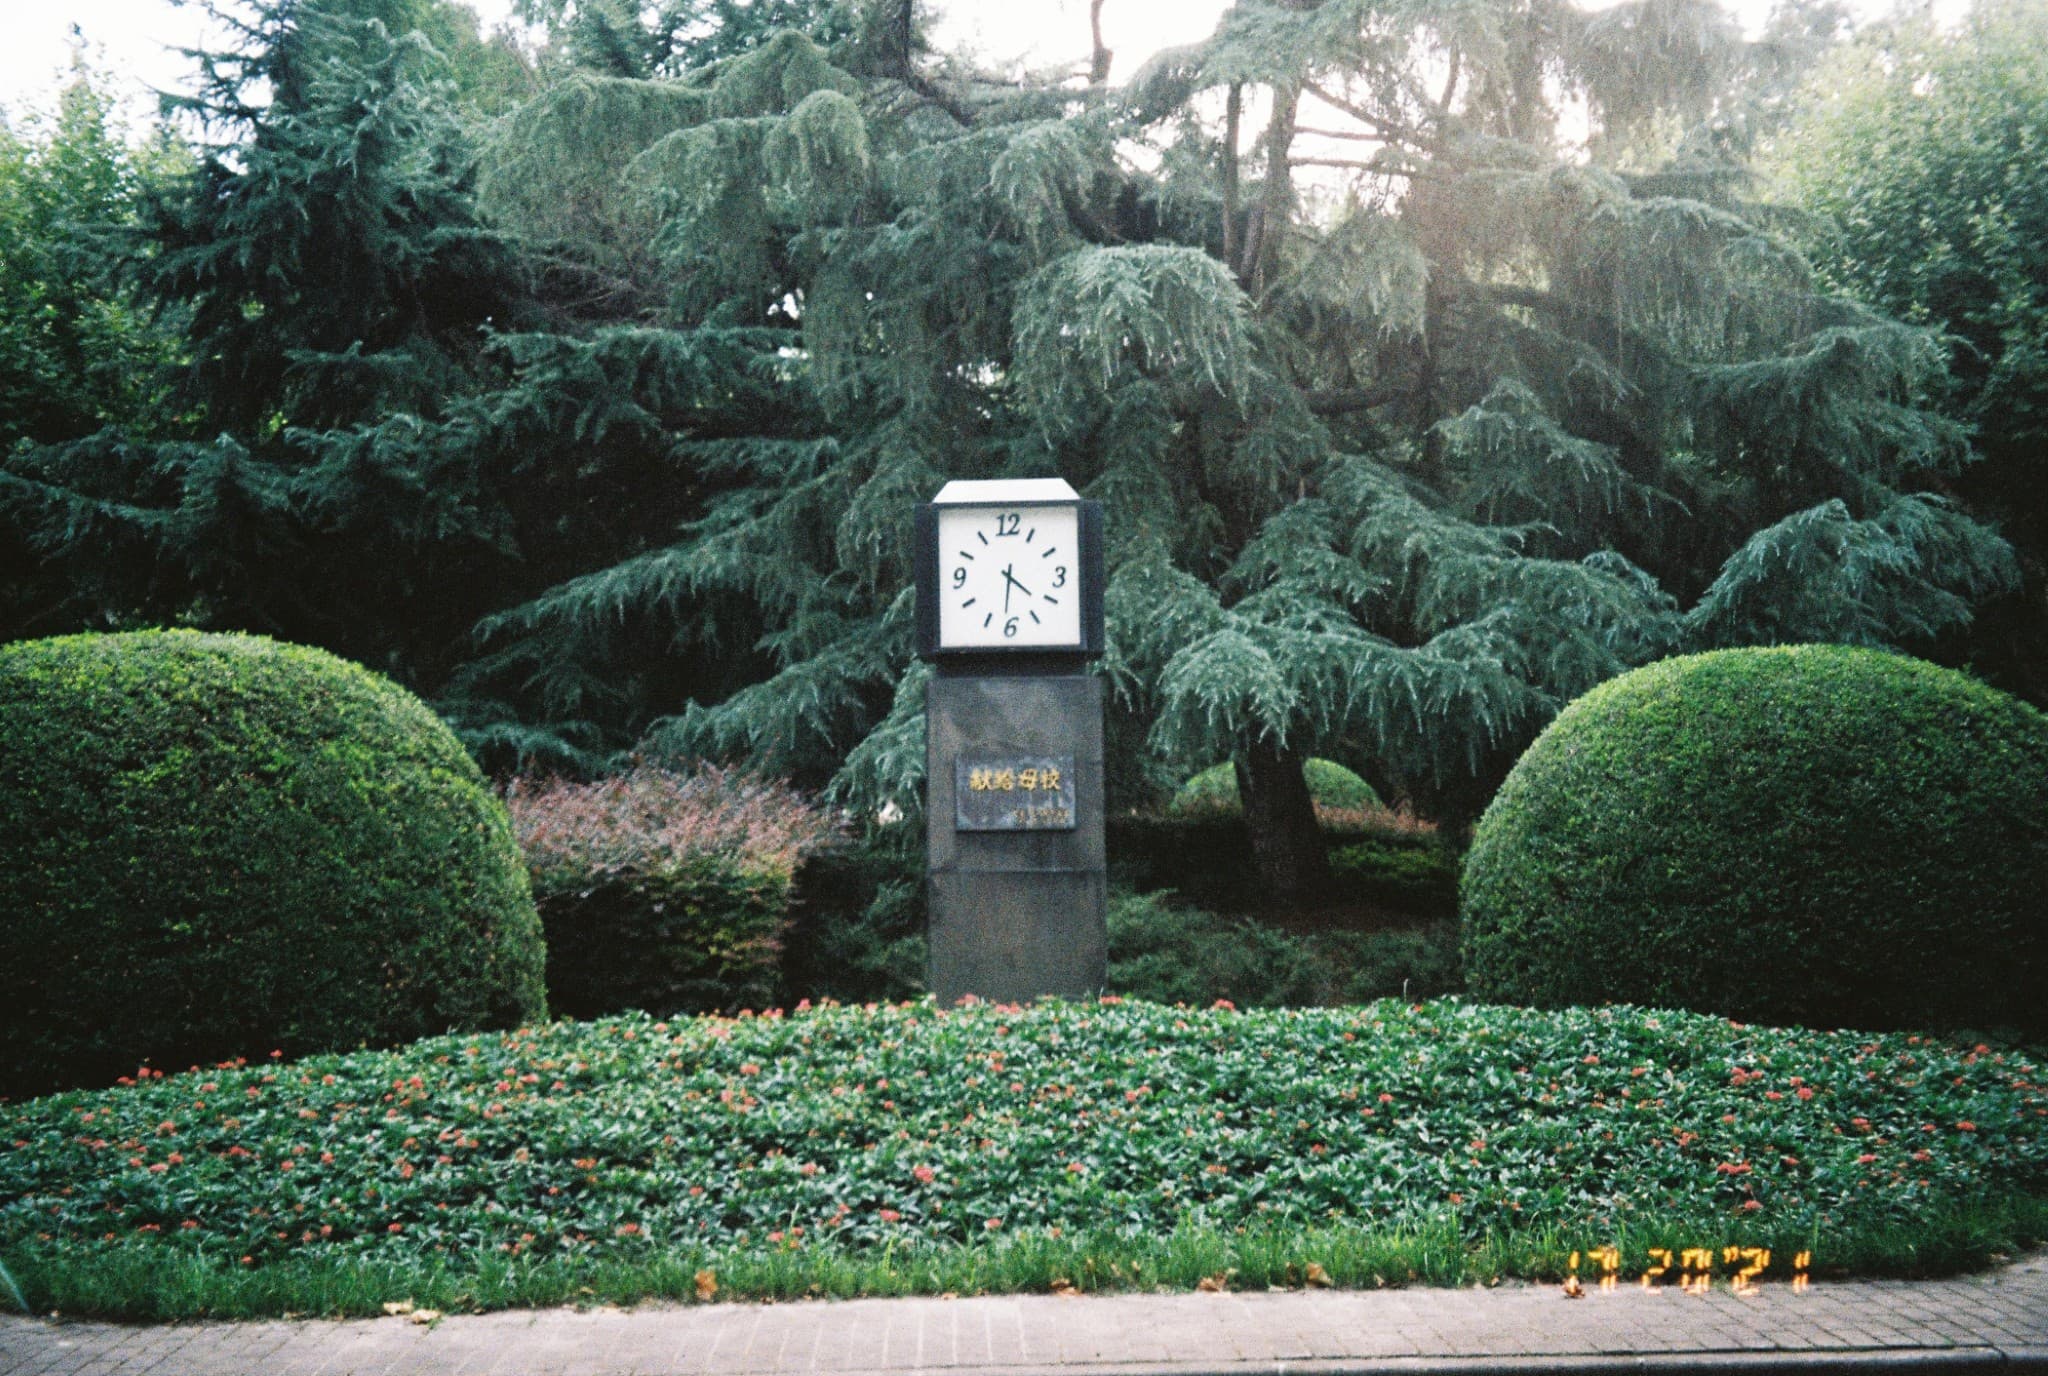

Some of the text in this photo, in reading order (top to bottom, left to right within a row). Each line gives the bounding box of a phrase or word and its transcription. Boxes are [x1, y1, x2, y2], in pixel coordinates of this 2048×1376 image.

[995, 513, 1021, 537] 12
[953, 567, 967, 589] 9
[1052, 566, 1067, 588] 3
[1004, 616, 1019, 637] 6
